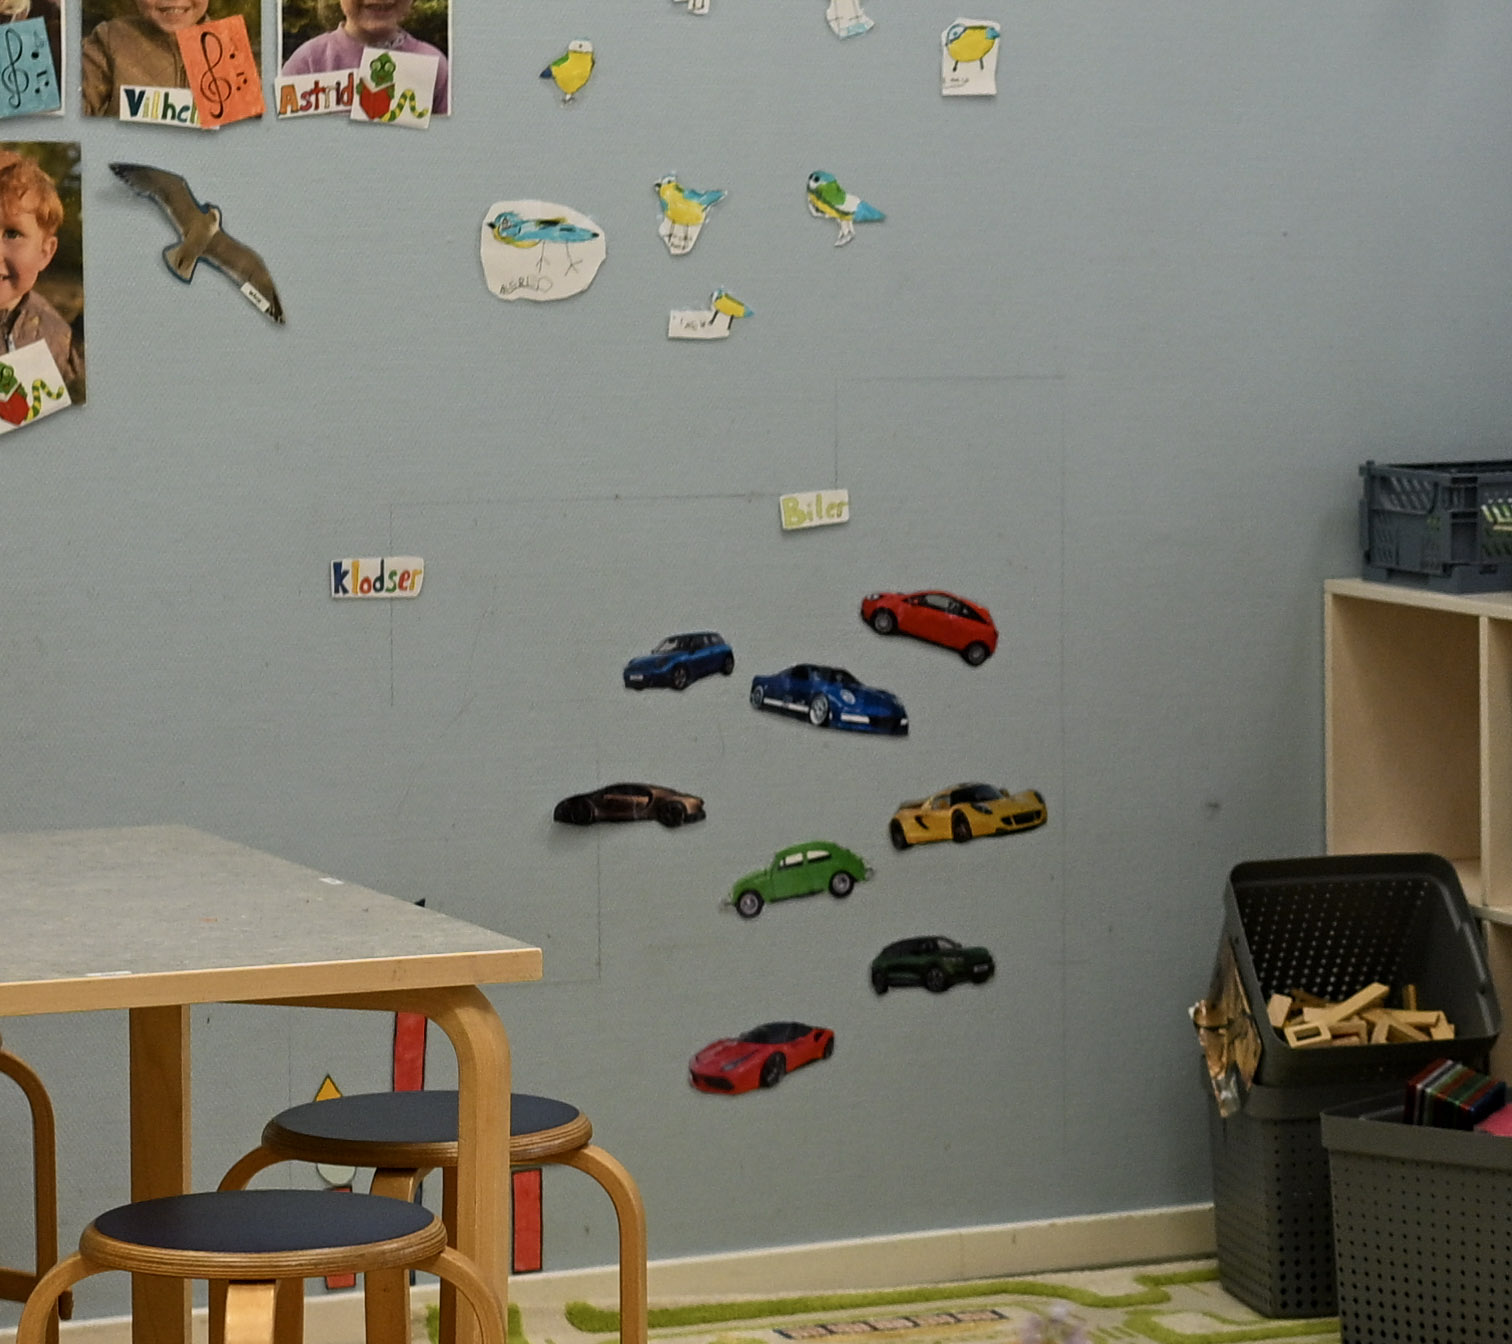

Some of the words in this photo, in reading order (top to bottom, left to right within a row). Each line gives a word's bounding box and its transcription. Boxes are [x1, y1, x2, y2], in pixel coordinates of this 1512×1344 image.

[124, 87, 202, 125] Vilhel
[279, 71, 355, 115] Astrid
[782, 493, 849, 528] Biler
